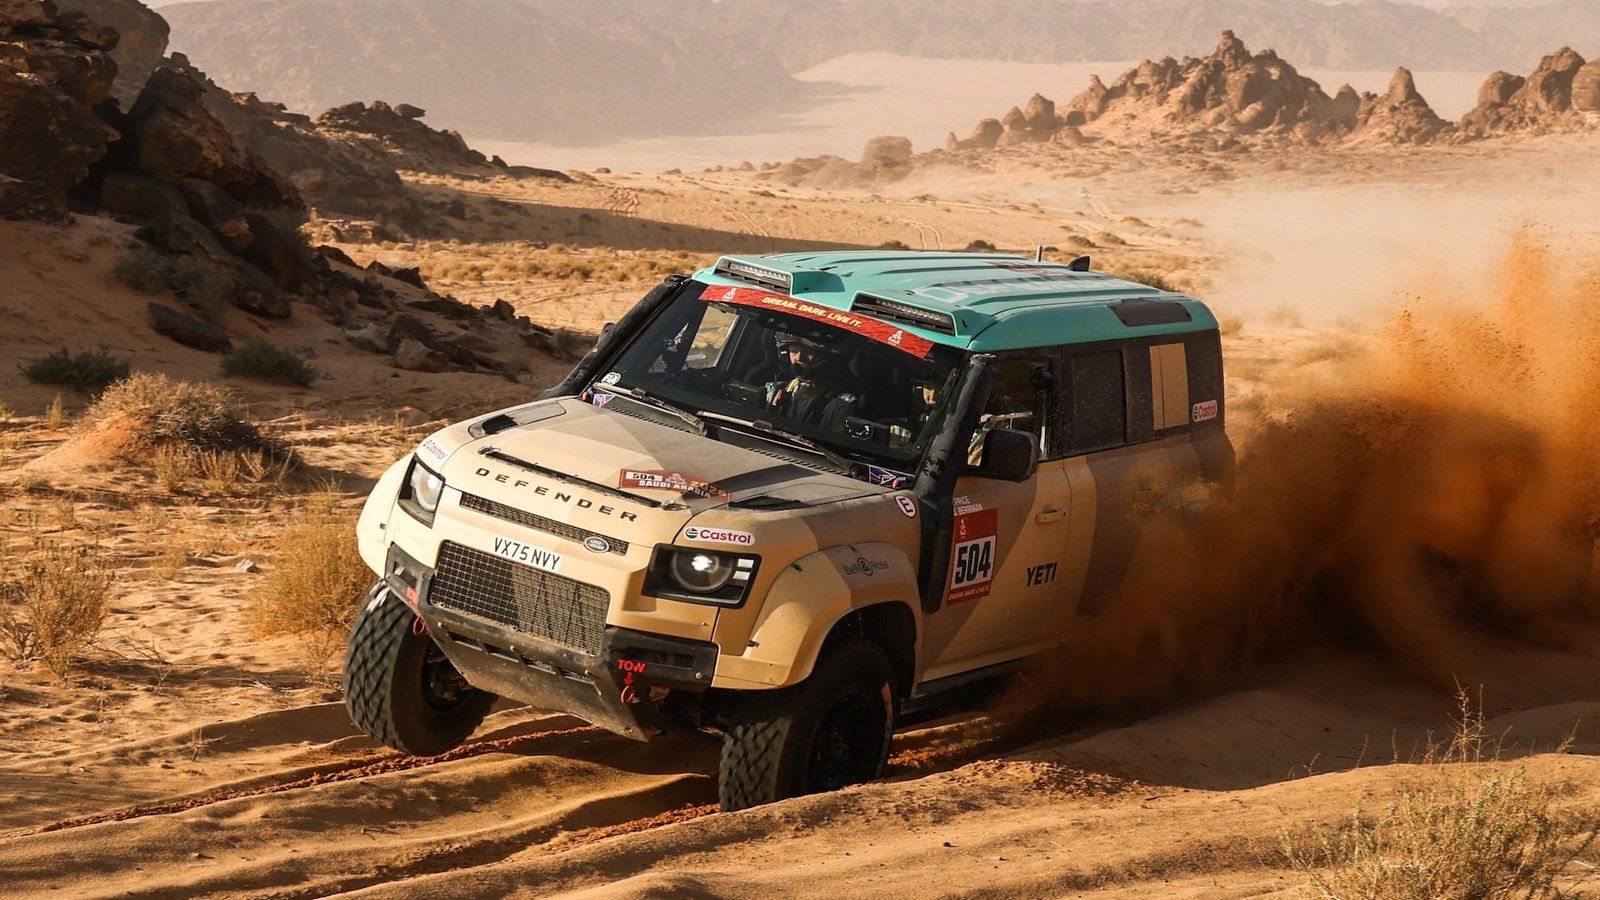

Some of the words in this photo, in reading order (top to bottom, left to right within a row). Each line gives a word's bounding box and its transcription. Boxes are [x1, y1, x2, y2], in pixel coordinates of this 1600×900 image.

[762, 297, 798, 309] DREAM.
[798, 304, 826, 316] DARE.
[827, 313, 849, 324] LIVE
[848, 320, 862, 328] IT.
[632, 472, 656, 480] 504
[475, 467, 638, 522] DEFENDER
[639, 480, 671, 489] SAUDI
[673, 483, 711, 498] ARABIA
[899, 497, 914, 514] E
[700, 529, 751, 544] Castrol
[494, 537, 530, 561] VX75
[531, 548, 560, 570] NVY
[954, 541, 991, 585] 504
[1026, 561, 1058, 588] YETI
[616, 659, 646, 673] TOW
